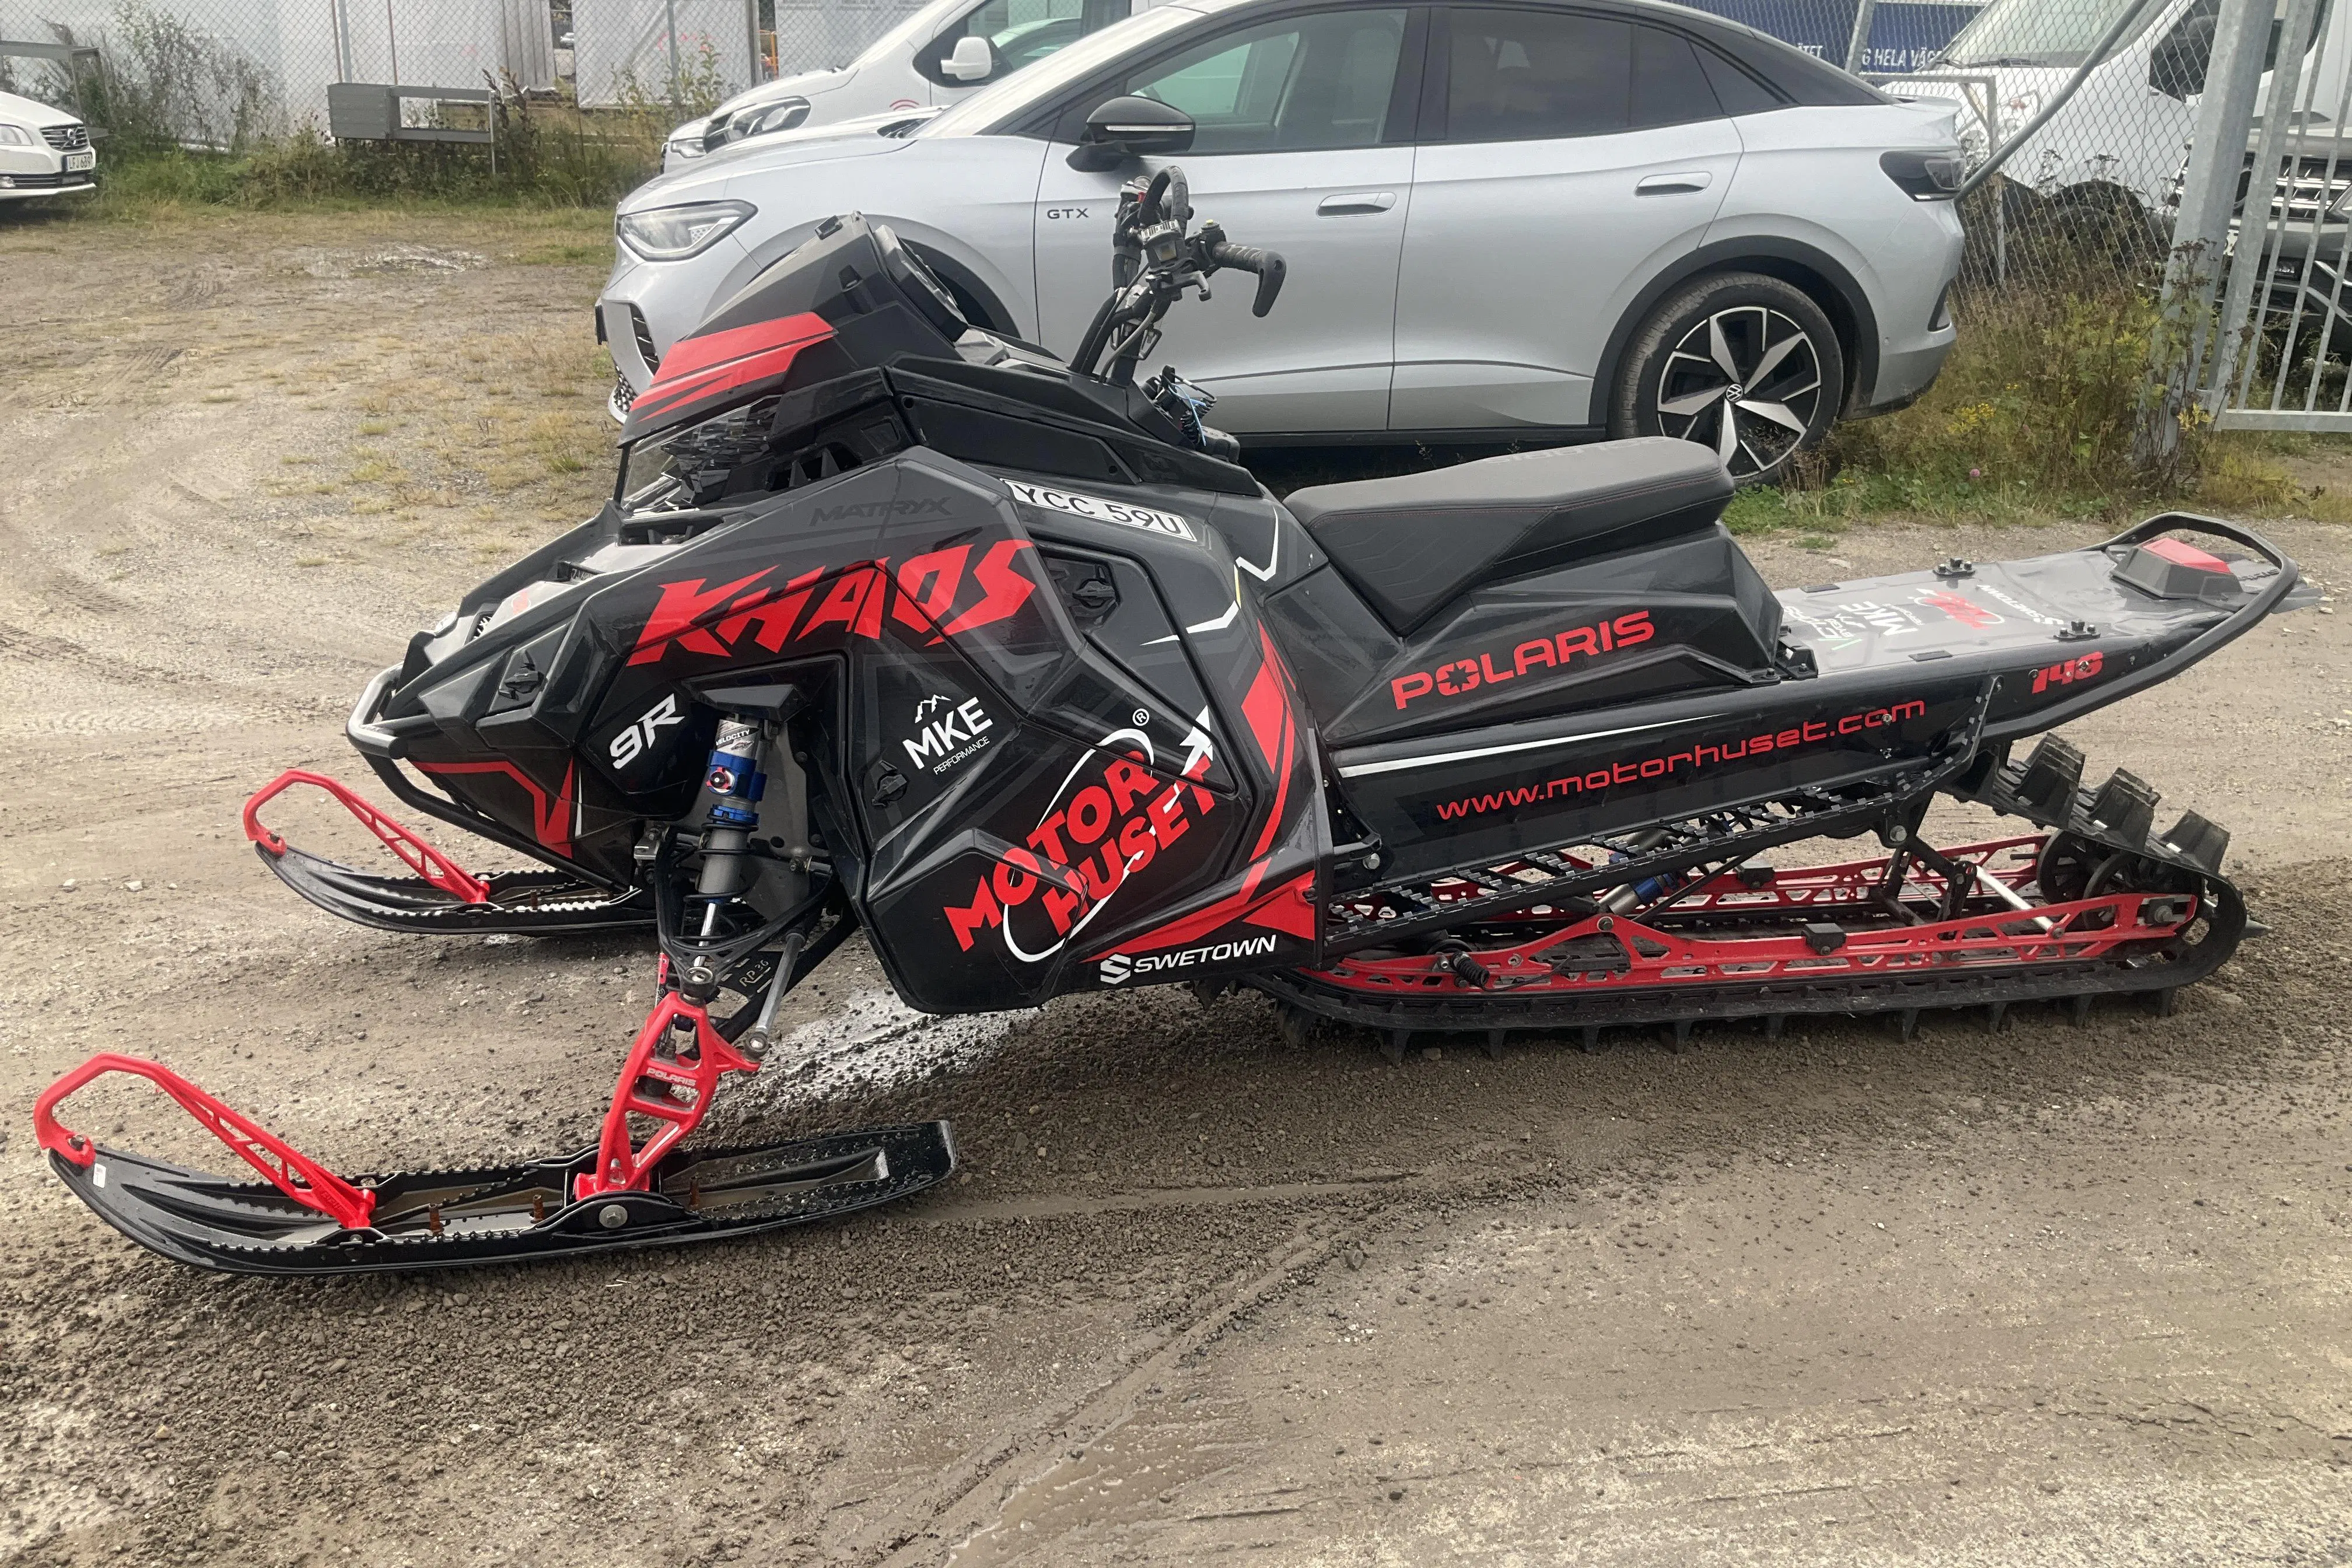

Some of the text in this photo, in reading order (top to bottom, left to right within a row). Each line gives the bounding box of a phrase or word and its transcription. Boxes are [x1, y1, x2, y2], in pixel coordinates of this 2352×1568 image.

[1874, 48, 1906, 66] HELA
[1047, 208, 1089, 219] GTX
[809, 496, 953, 526] MATRYX
[1014, 484, 1181, 534] YCC 59U
[627, 539, 1036, 666] KHAOS
[1839, 601, 1918, 636] MKE
[1391, 610, 1655, 709] POLARIS
[2031, 651, 2103, 694] 146
[610, 692, 684, 770] 9R
[716, 729, 750, 746] VELOCITY
[902, 696, 993, 770] MKE
[933, 736, 991, 776] PERFORMANCE
[1436, 700, 1926, 820] www.motorhuset.com
[944, 750, 1159, 952] MOTOR
[1042, 757, 1216, 937] HUSET
[1134, 934, 1276, 973] SWETOWN
[646, 1067, 696, 1086] POLARIS
